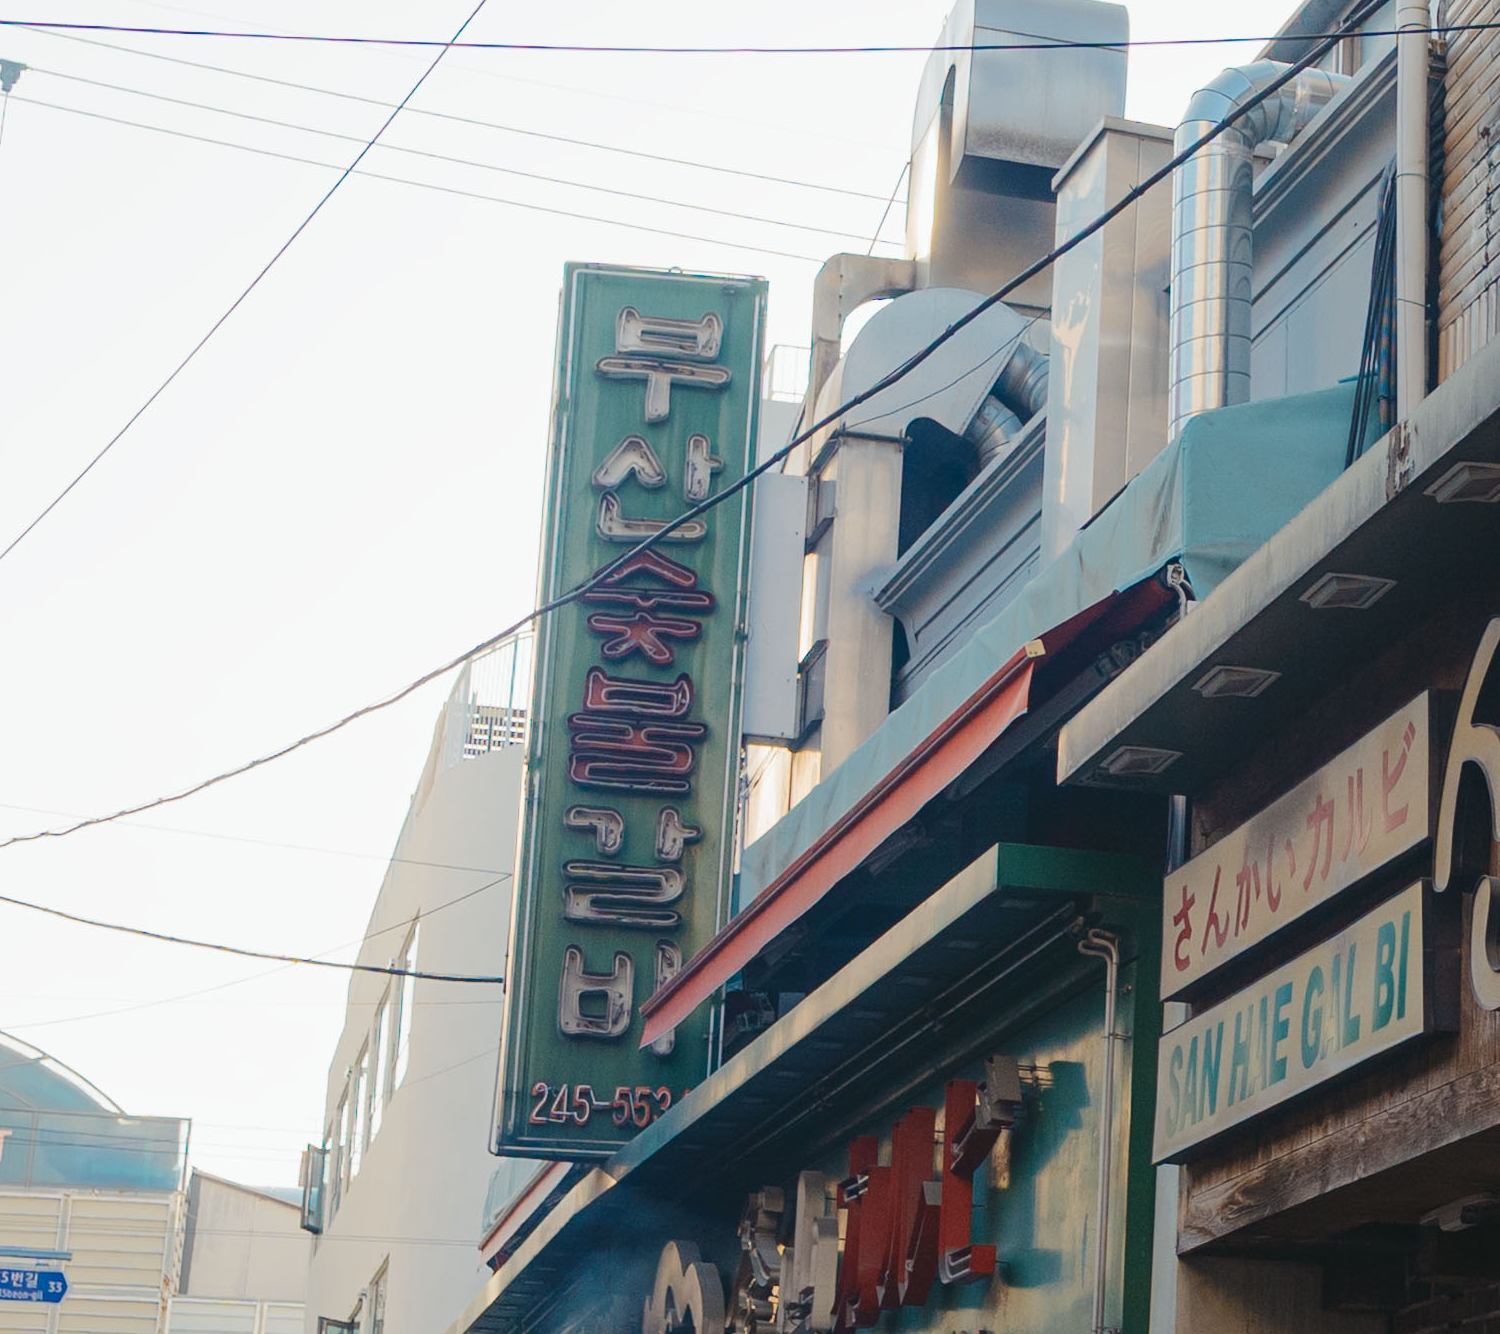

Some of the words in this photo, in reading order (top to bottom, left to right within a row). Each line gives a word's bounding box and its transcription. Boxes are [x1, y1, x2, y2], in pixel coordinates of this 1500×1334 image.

[557, 304, 732, 1055] 부산숯불갈비
[1173, 721, 1417, 972] さんかいカルビ
[530, 1080, 690, 1129] 245-553
[1164, 1020, 1225, 1140] SAN
[1227, 980, 1294, 1108] HAE
[1300, 942, 1362, 1070] GAL
[1371, 910, 1411, 1034] BI
[47, 1280, 63, 1293] 33
